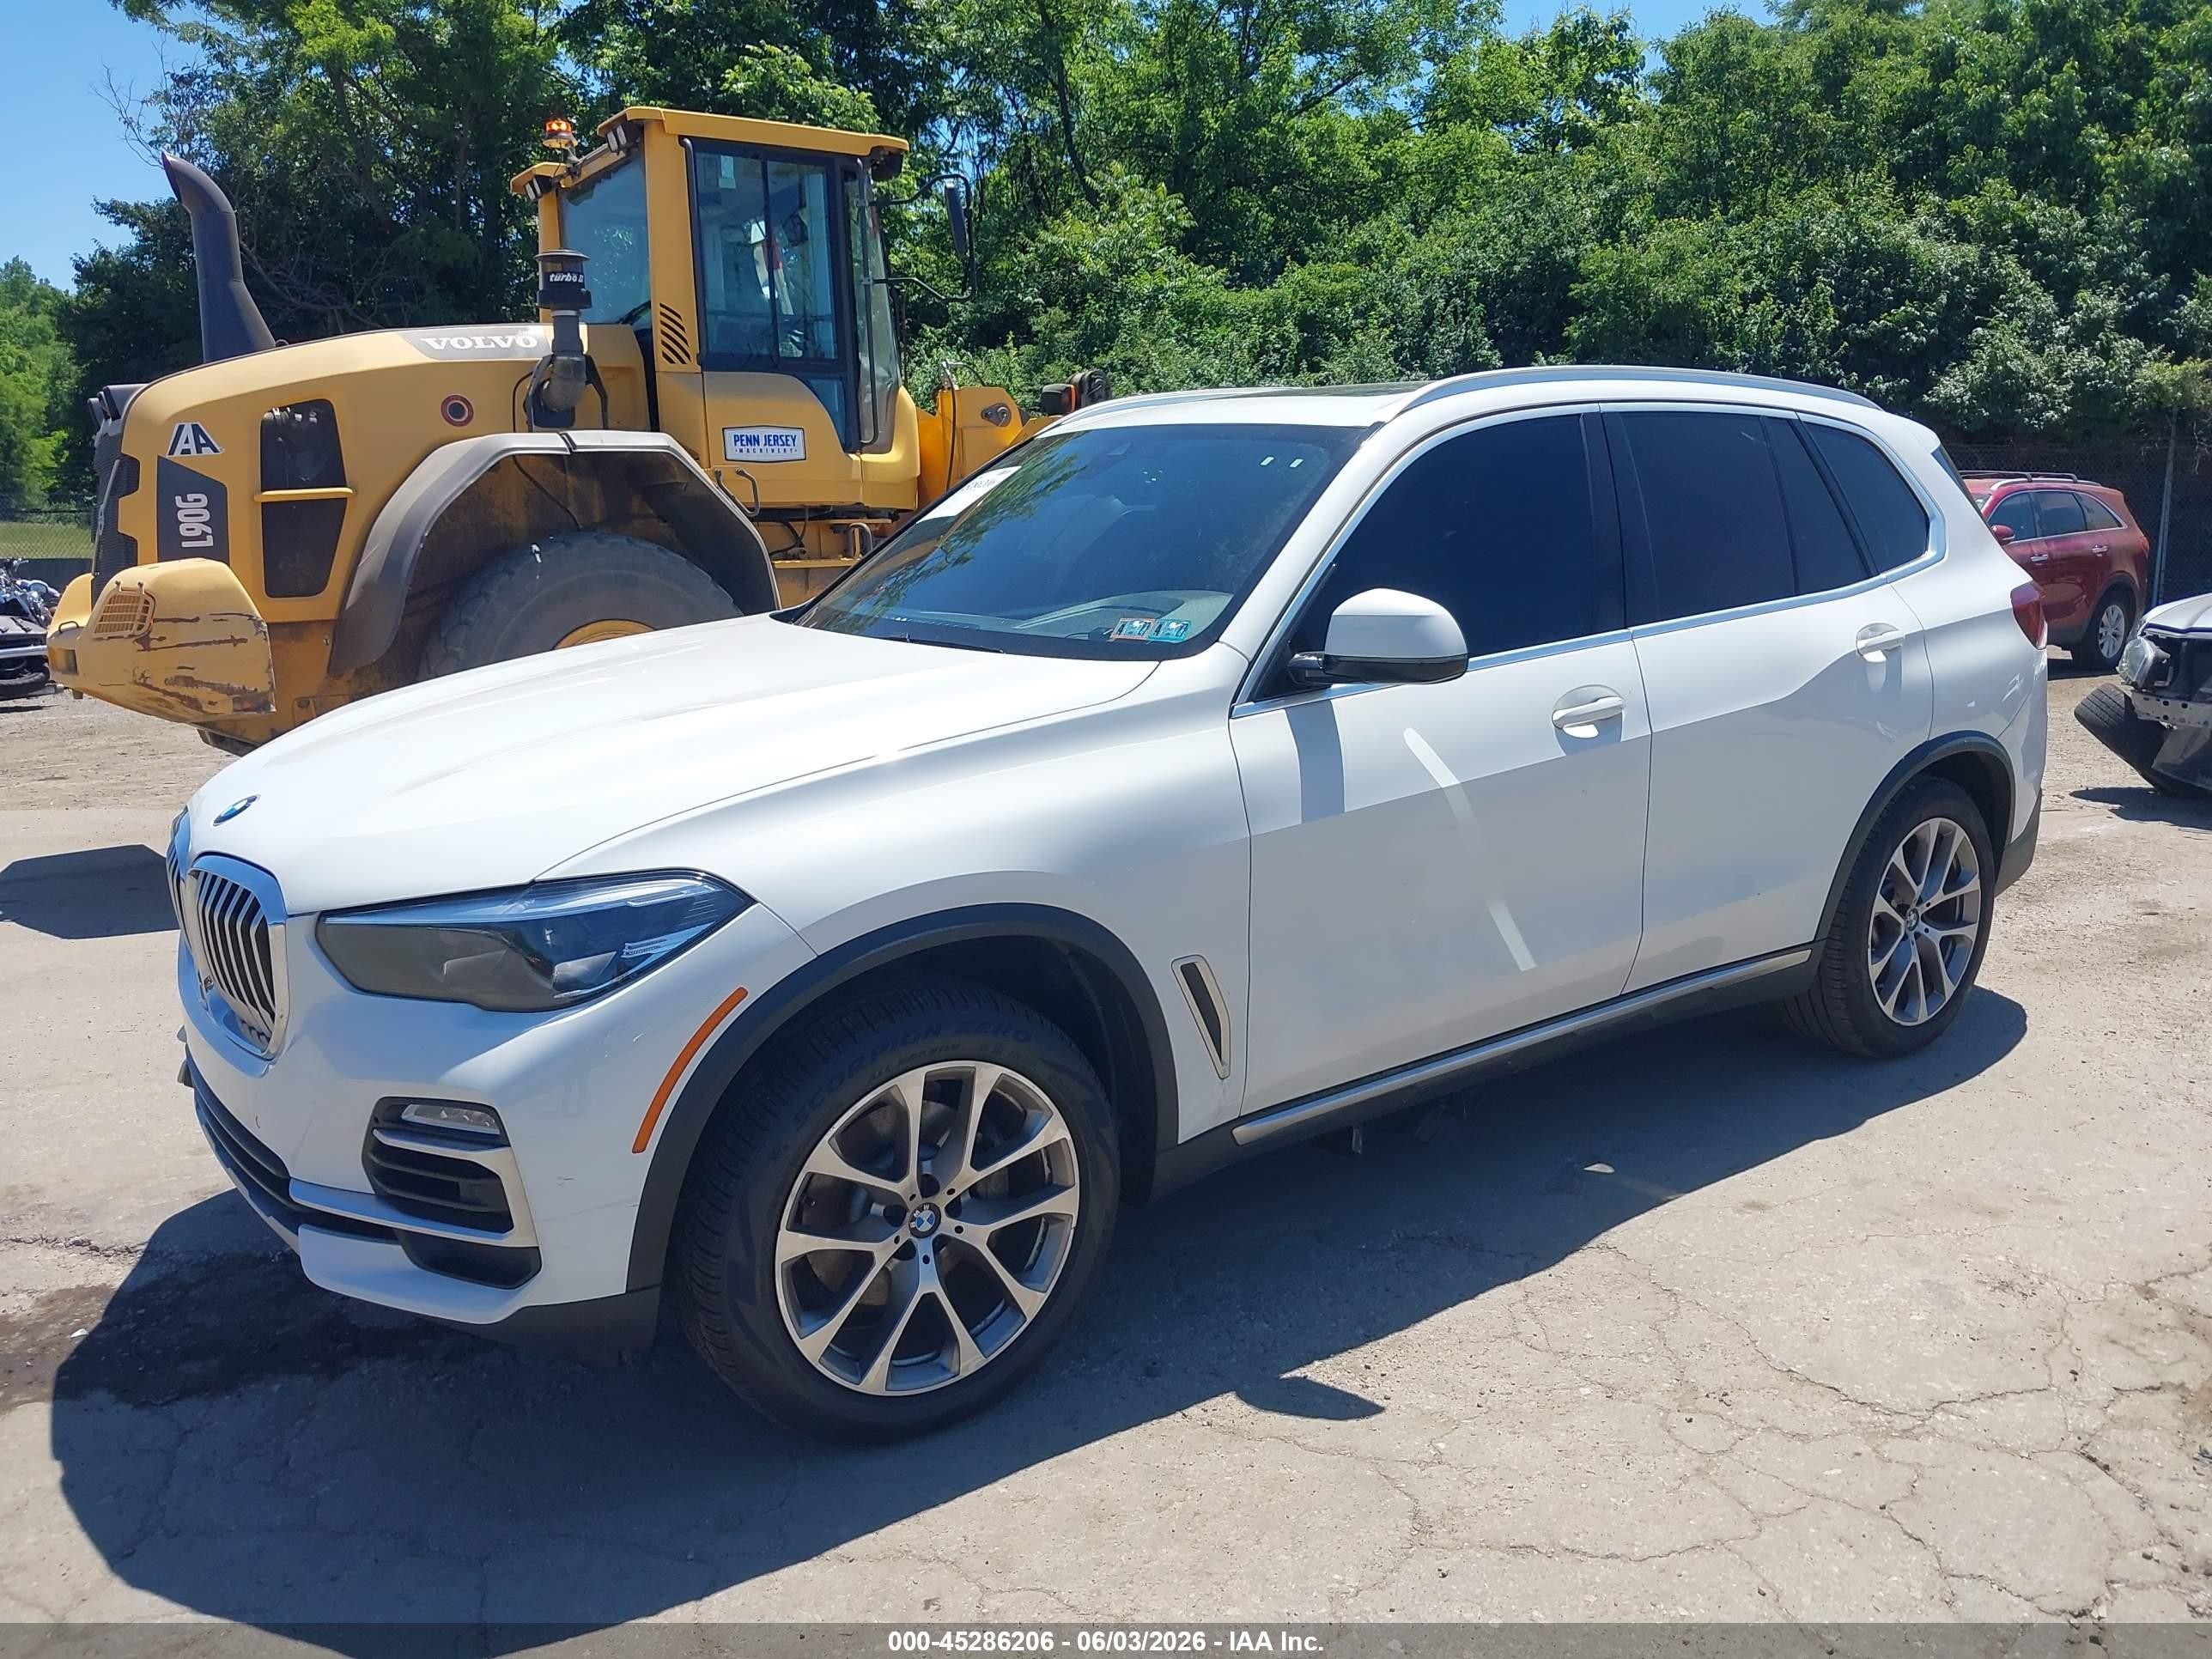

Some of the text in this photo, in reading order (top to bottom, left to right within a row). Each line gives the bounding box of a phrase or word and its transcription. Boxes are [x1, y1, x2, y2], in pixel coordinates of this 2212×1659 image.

[550, 273, 578, 283] turbo
[421, 336, 538, 350] VOLVO
[733, 434, 797, 447] PENN JERSEY
[175, 493, 214, 548] L90G
[792, 1023, 943, 1131] SCORPION
[910, 1203, 930, 1228] BMW
